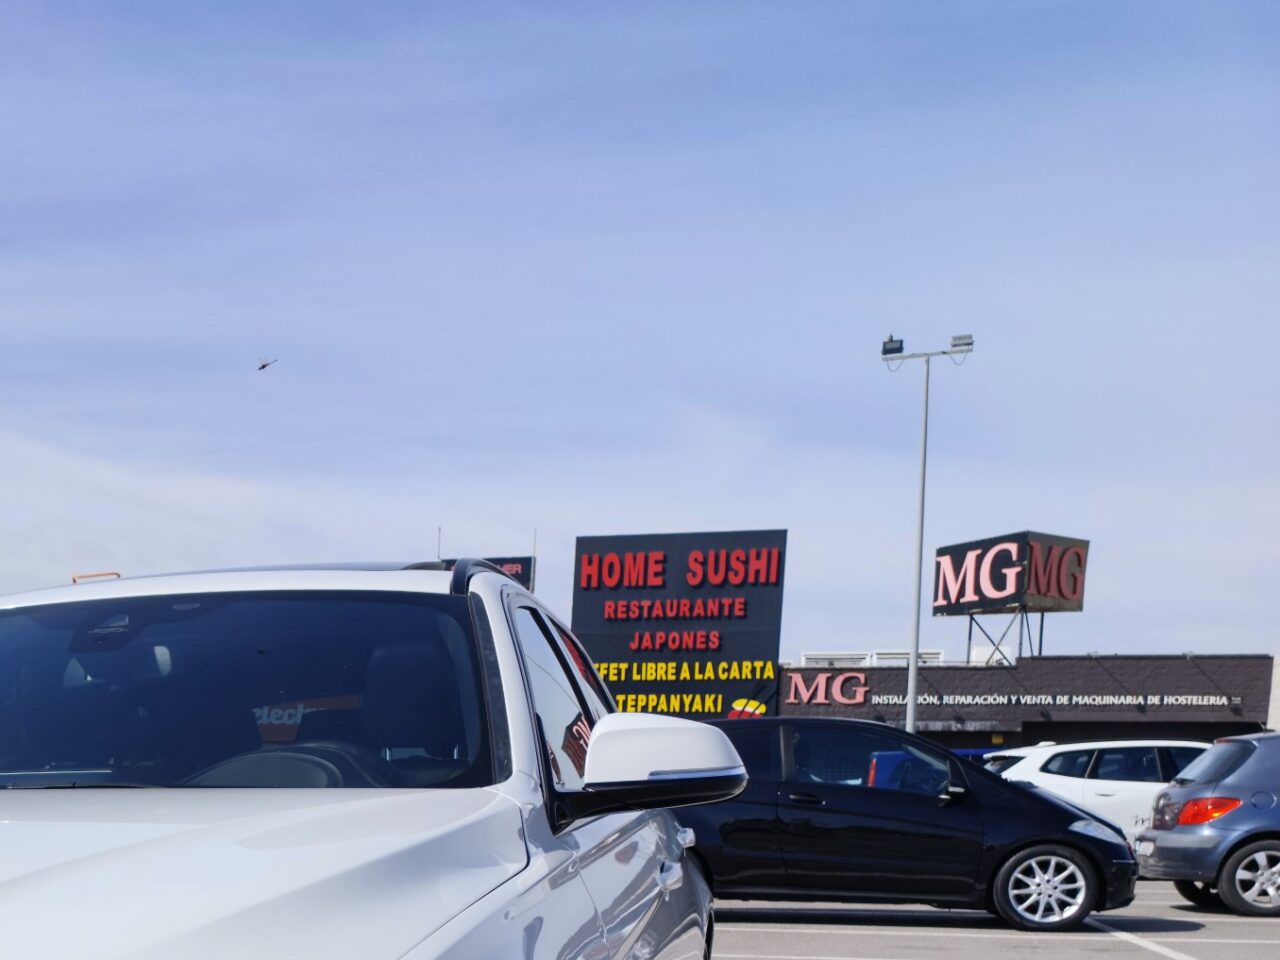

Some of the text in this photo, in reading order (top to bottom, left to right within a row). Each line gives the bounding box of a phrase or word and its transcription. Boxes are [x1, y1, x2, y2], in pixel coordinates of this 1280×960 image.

[580, 547, 780, 589] HOME SUSHI
[933, 542, 1022, 607] MG
[1027, 540, 1087, 600] MG
[604, 597, 746, 620] RESTAURANTE
[629, 630, 720, 651] JAPONES
[632, 661, 677, 682] LIBRE
[680, 661, 691, 681] A
[694, 661, 715, 681] LA
[719, 660, 775, 681] CARTA
[787, 672, 869, 704] MG
[872, 692, 940, 706] INSTALAIÓN,
[1010, 695, 1018, 705] Y
[1020, 695, 1053, 705] VENTA
[1056, 695, 1069, 705] DE
[1072, 695, 1146, 706] MAQUINARIA
[1147, 695, 1161, 705] DE
[1163, 695, 1228, 706] HOSTELERIA
[616, 694, 724, 713] TEPPANYAKI
